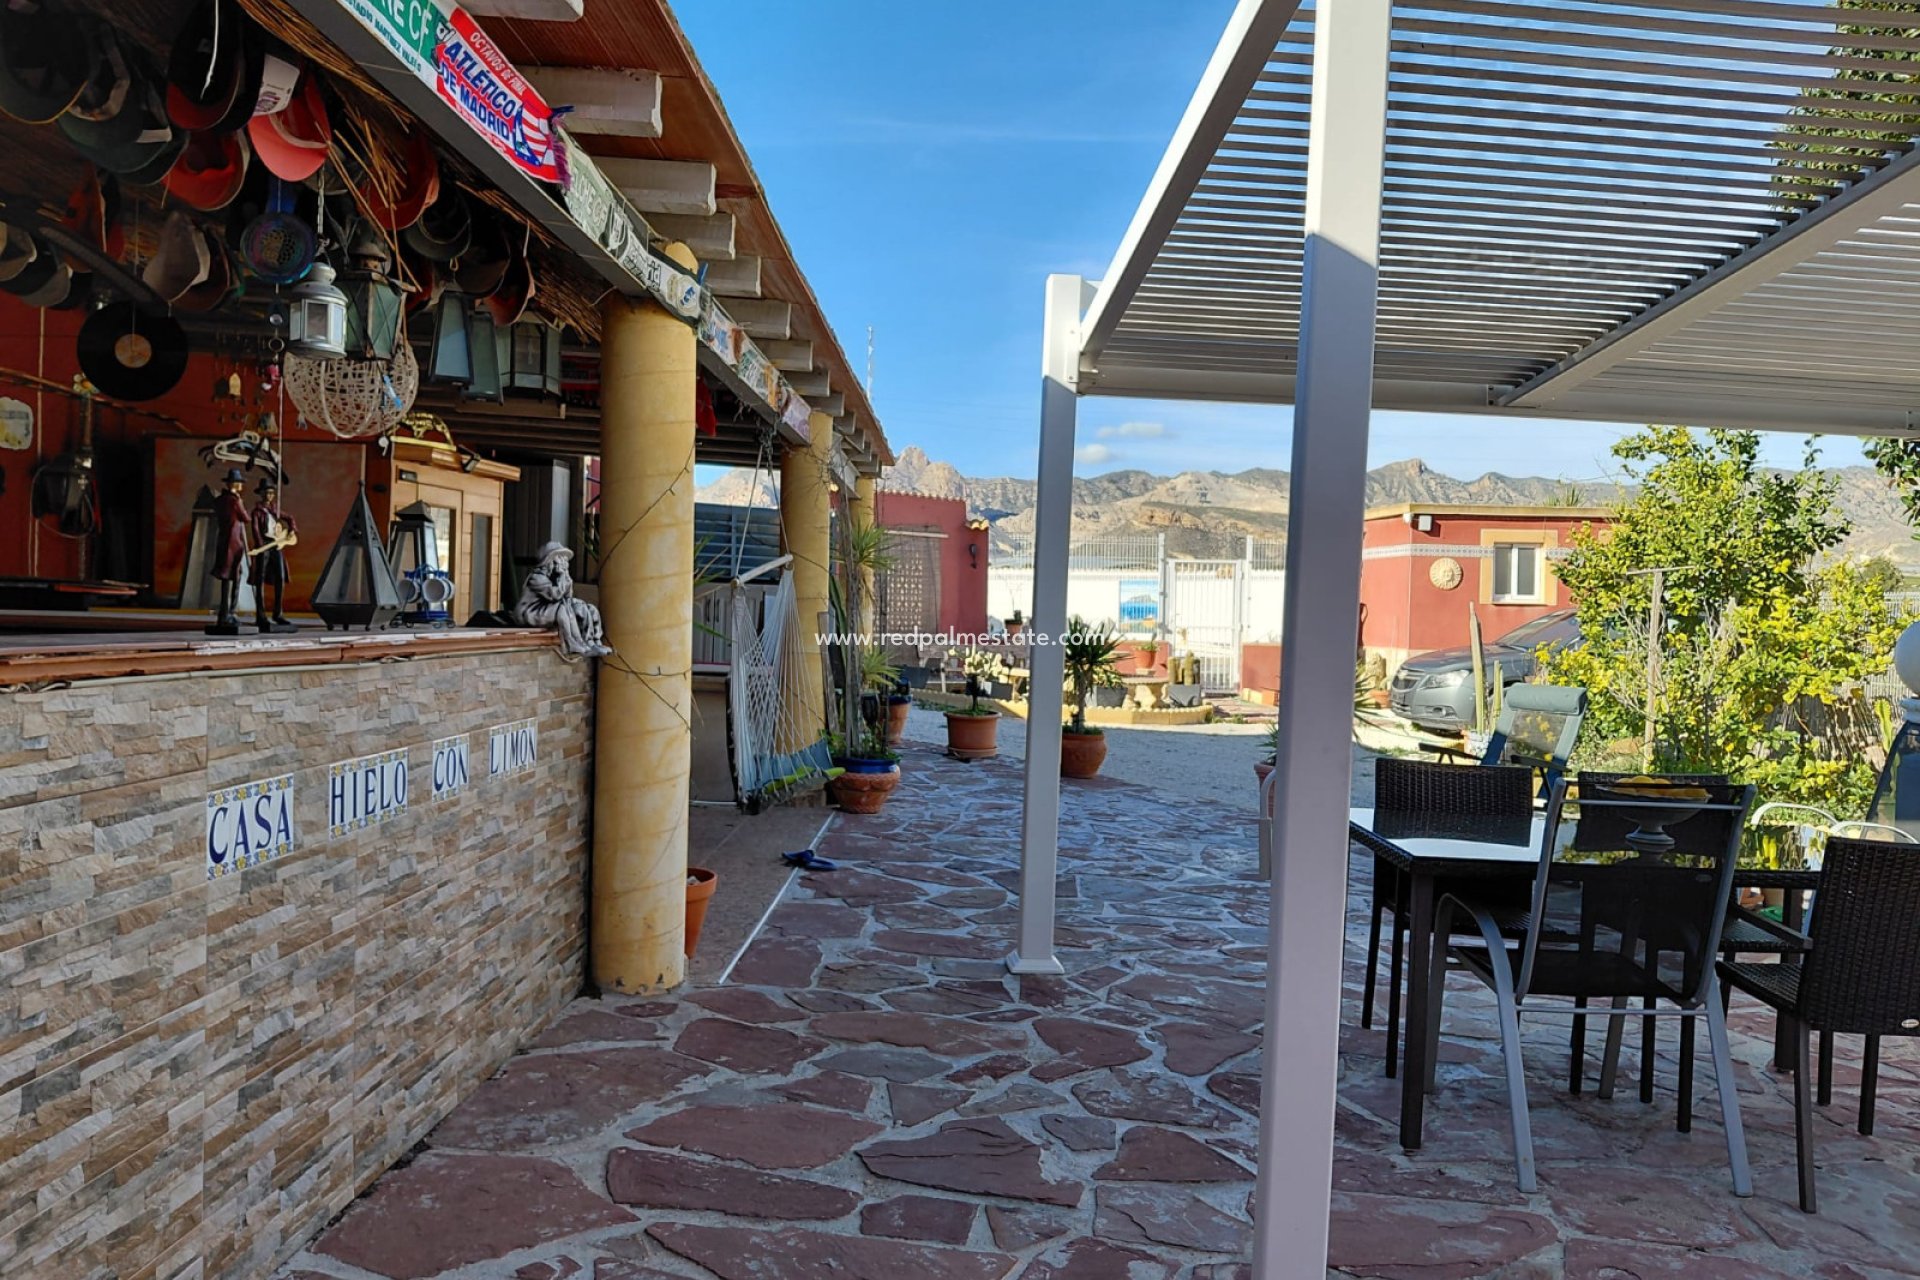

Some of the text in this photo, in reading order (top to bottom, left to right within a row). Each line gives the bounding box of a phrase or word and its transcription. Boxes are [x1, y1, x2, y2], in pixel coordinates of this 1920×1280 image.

[408, 0, 433, 41] CF
[470, 32, 506, 71] OCTAVOS
[440, 61, 457, 95] DE
[459, 83, 510, 141] MADRID
[444, 41, 517, 118] ATLÉTICO
[208, 729, 536, 864] CASA HIELO CON LIMON
